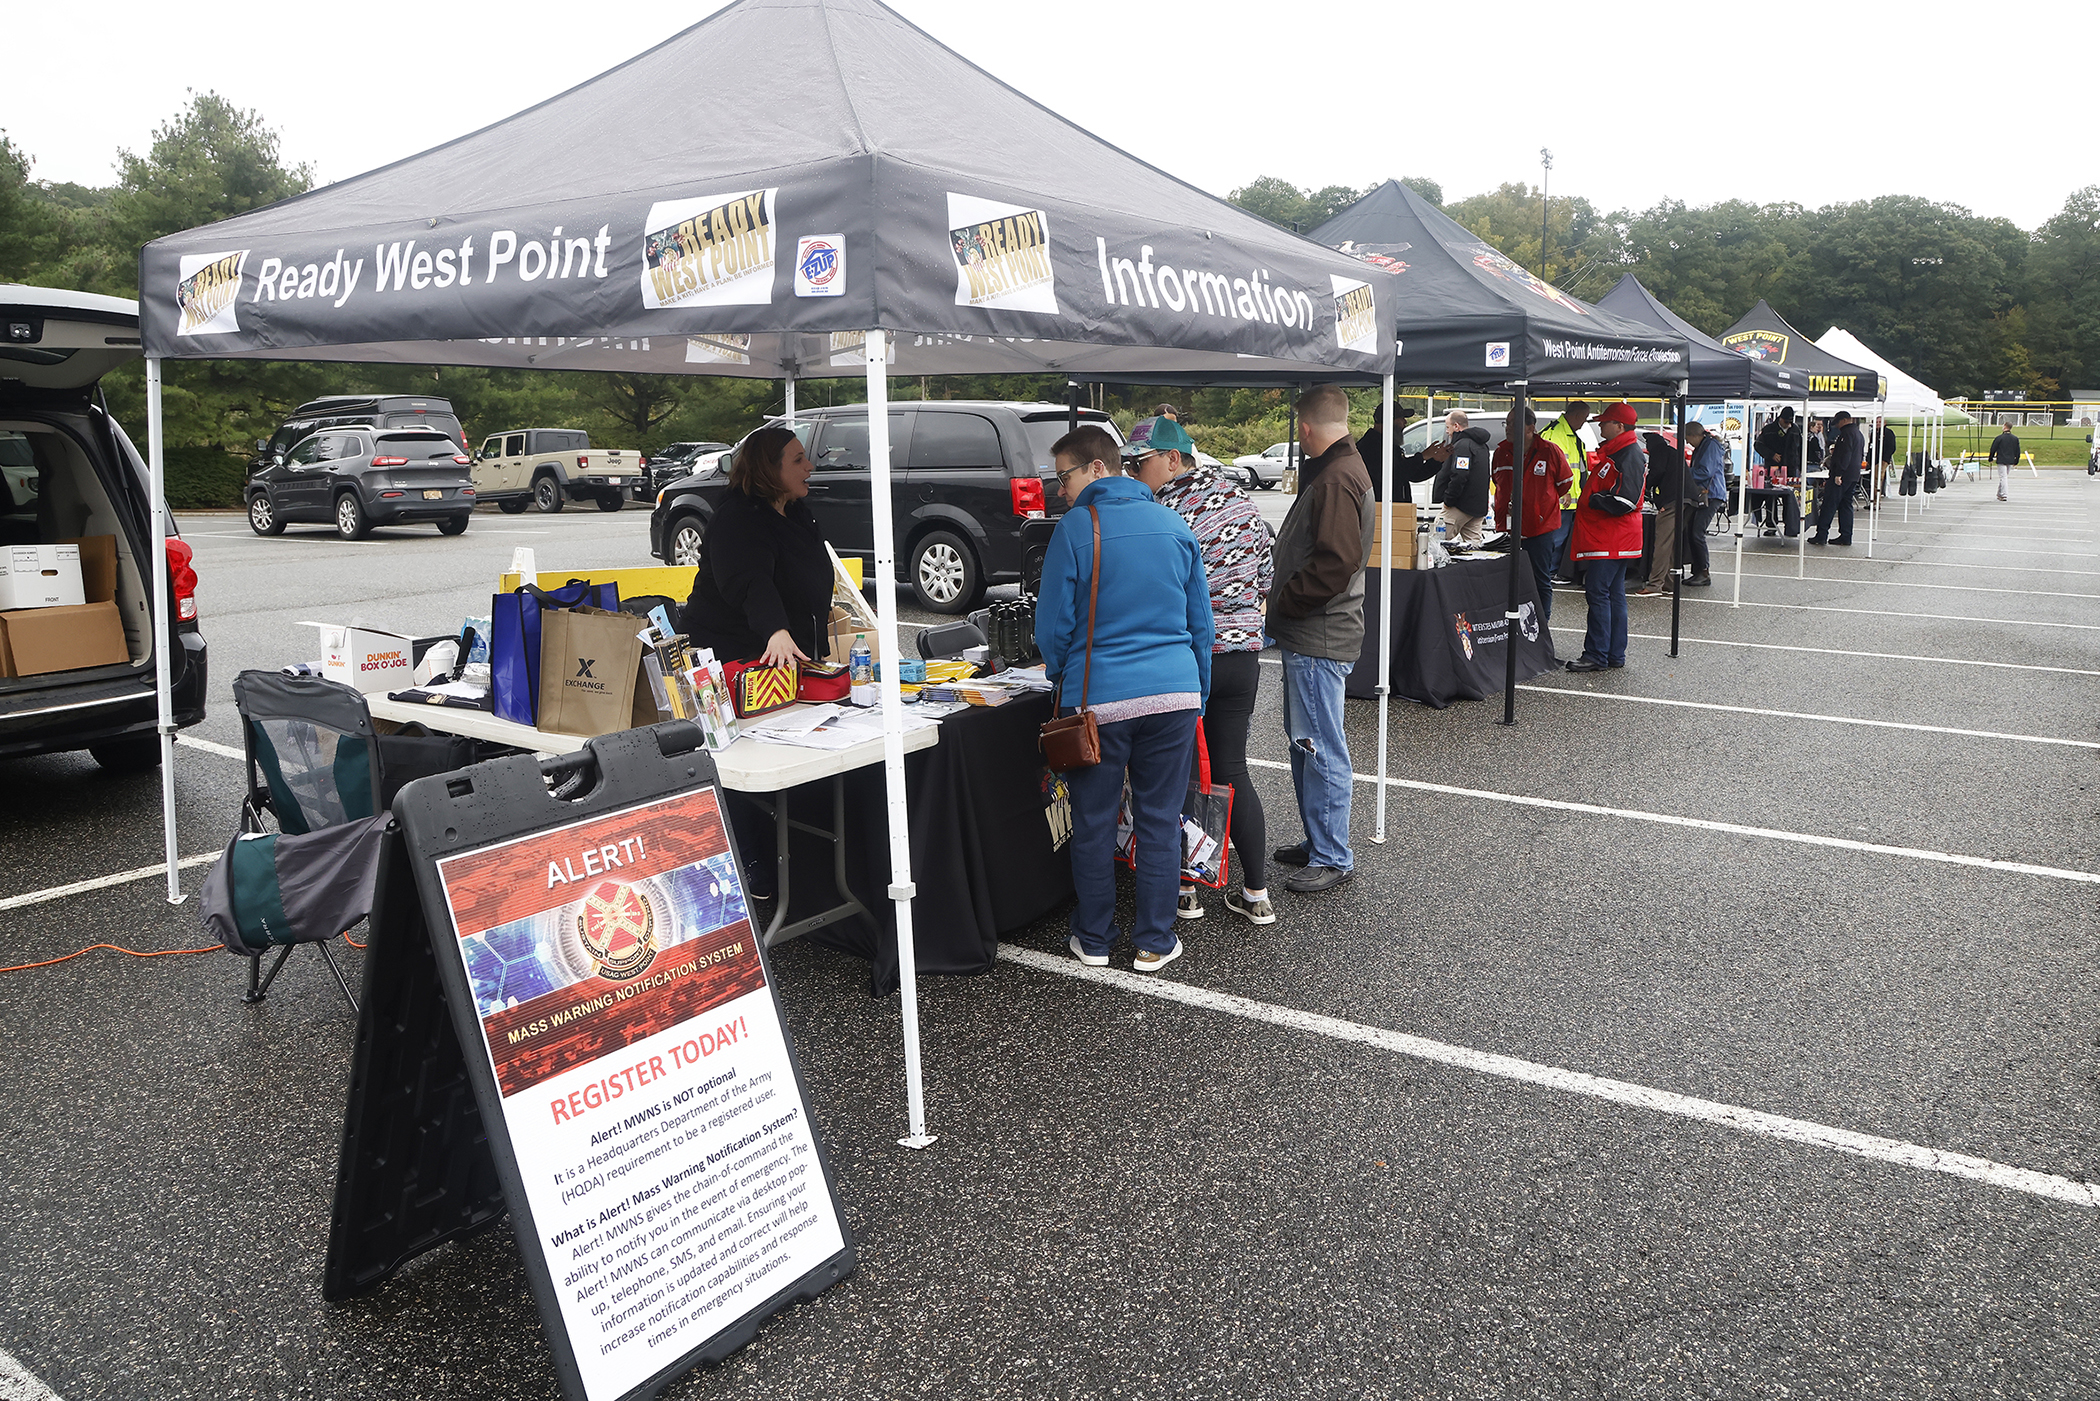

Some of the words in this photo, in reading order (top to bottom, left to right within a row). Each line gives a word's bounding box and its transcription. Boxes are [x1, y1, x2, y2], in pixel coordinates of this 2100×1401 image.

[679, 192, 764, 257] READY
[979, 212, 1042, 260] READY
[195, 253, 242, 297] READY
[252, 249, 364, 309] Ready
[375, 235, 474, 293] West
[485, 224, 612, 285] Point
[650, 251, 707, 301] WEST
[710, 225, 770, 280] POINT
[660, 298, 676, 306] MAKE
[694, 286, 710, 295] HAVE
[743, 260, 774, 278] INFORMED
[963, 256, 1010, 299] WEST
[1006, 244, 1050, 286] POINT
[1096, 236, 1314, 332] Information
[1345, 285, 1371, 317] READY
[1542, 339, 1565, 358] West
[1565, 340, 1586, 359] Point
[1648, 347, 1681, 363] Protection
[1728, 333, 1754, 344] WEST
[1756, 333, 1784, 343] POINT
[1808, 375, 1857, 392] TMENT
[361, 662, 379, 671] BOX
[381, 658, 407, 669] O'JOE
[367, 651, 401, 662] DUNKIN'
[565, 680, 605, 690] EXCHANGE
[576, 658, 596, 678] X
[1045, 801, 1073, 845] WE
[547, 835, 647, 888] ALERT!
[507, 1020, 548, 1045] MASS
[550, 993, 613, 1028] WARNING
[616, 963, 698, 1003] NOTIFICATION
[699, 942, 744, 970] SYSTEM
[601, 968, 619, 978] USAG
[620, 968, 639, 977] WEST
[639, 950, 654, 970] POINT
[550, 1055, 667, 1125] REGISTER
[667, 1015, 748, 1070] TODAY!
[554, 1173, 564, 1185] It
[565, 1168, 576, 1179] is
[578, 1164, 585, 1174] a
[586, 1127, 660, 1169] Headquarters
[660, 1097, 719, 1133] Department
[720, 1088, 730, 1103] of
[731, 1083, 747, 1097] the
[749, 1071, 772, 1089] Army
[590, 1121, 622, 1147] Alert!
[623, 1103, 662, 1130] MWNS
[662, 1100, 672, 1111] is
[672, 1086, 694, 1107] NOT
[696, 1066, 737, 1095] optional
[550, 1223, 585, 1248] What
[585, 1218, 597, 1230] is
[599, 1197, 631, 1224] Alert!
[631, 1184, 661, 1206] Mass
[661, 1160, 706, 1189] Warning
[705, 1130, 762, 1166] Notification
[761, 1107, 798, 1136] System?
[561, 1173, 605, 1206] (HQDA)
[606, 1140, 672, 1181] requirement
[672, 1135, 684, 1147] to
[685, 1128, 698, 1140] be
[700, 1124, 707, 1133] a
[708, 1096, 754, 1129] registered
[754, 1088, 776, 1105] user.
[564, 1260, 599, 1287] ability
[600, 1253, 614, 1266] to
[615, 1233, 647, 1258] notify
[648, 1222, 669, 1242] you
[669, 1216, 680, 1227] in
[681, 1205, 699, 1221] the
[700, 1188, 728, 1210] event
[728, 1179, 739, 1194] of
[740, 1154, 791, 1187] emergency.
[790, 1143, 808, 1157] The
[572, 1233, 604, 1261] Alert!
[605, 1212, 645, 1242] MWNS
[645, 1199, 673, 1223] gives
[673, 1189, 691, 1205] the
[692, 1138, 778, 1194] chain-of-command
[778, 1131, 793, 1146] the
[577, 1275, 609, 1303] Alert!
[609, 1252, 649, 1283] MWNS
[650, 1243, 669, 1260] can
[670, 1204, 736, 1248] communicate
[736, 1195, 751, 1209] via
[752, 1174, 787, 1201] desktop
[788, 1163, 808, 1181] pop-
[590, 1301, 610, 1316] up,
[610, 1266, 669, 1304] telephone,
[669, 1248, 696, 1270] SMS,
[697, 1233, 717, 1254] and
[717, 1217, 747, 1241] email.
[746, 1194, 787, 1223] Ensuring
[786, 1181, 806, 1200] your
[600, 1289, 665, 1333] information
[665, 1282, 675, 1293] is
[676, 1253, 718, 1287] updated
[719, 1241, 738, 1261] and
[738, 1223, 771, 1249] correct
[771, 1210, 788, 1228] will
[788, 1200, 808, 1218] help
[599, 1321, 646, 1356] increase
[647, 1284, 706, 1326] notification
[707, 1250, 760, 1289] capabilities
[760, 1236, 778, 1256] and
[779, 1214, 818, 1243] response
[647, 1323, 678, 1348] times
[678, 1317, 689, 1328] in
[690, 1281, 743, 1321] emergency
[744, 1252, 791, 1287] situations.
